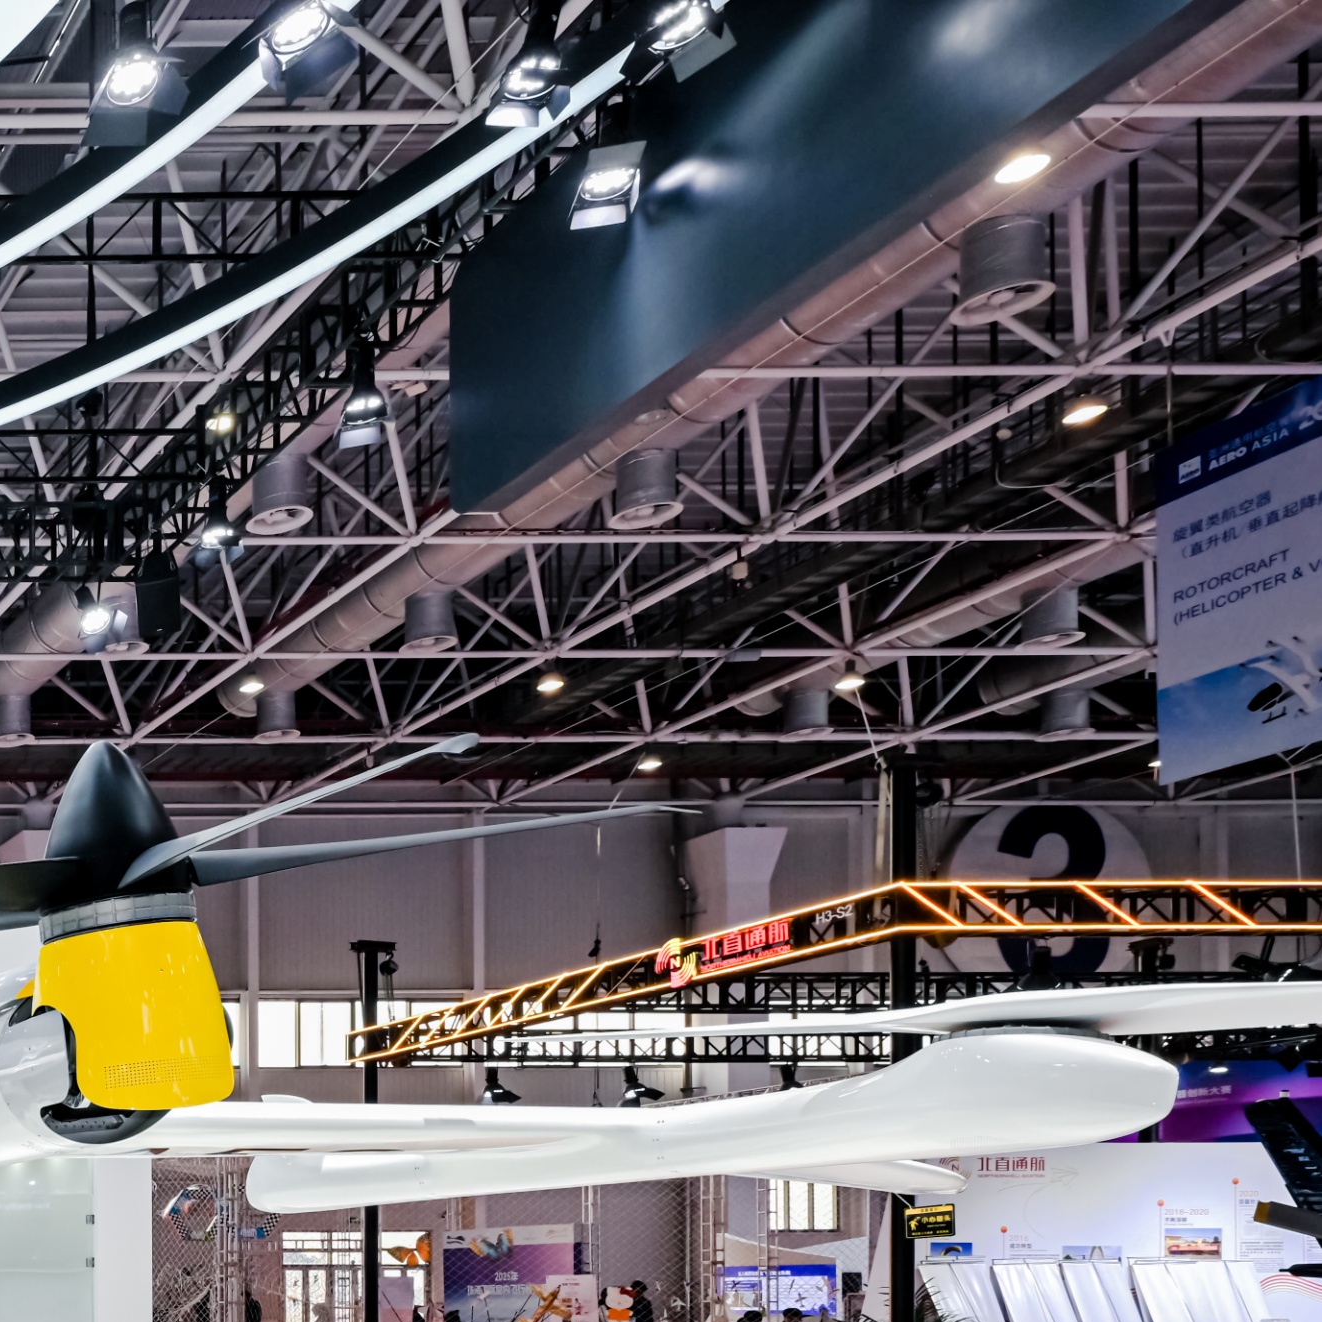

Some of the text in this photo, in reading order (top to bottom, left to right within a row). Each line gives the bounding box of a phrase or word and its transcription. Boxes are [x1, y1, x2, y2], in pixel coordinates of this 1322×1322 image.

[1209, 447, 1247, 471] AERO
[1252, 428, 1289, 452] ASIA
[1173, 490, 1271, 543] 旋翼类航空器
[1173, 548, 1290, 603] ROTORCRAFT
[1173, 572, 1287, 626] (HELICOPTER
[1292, 566, 1303, 580] &
[815, 904, 853, 925] H3-S2
[701, 918, 791, 962] 北直通航
[758, 944, 791, 959] AVIATION
[977, 1157, 1045, 1171] 北直通航
